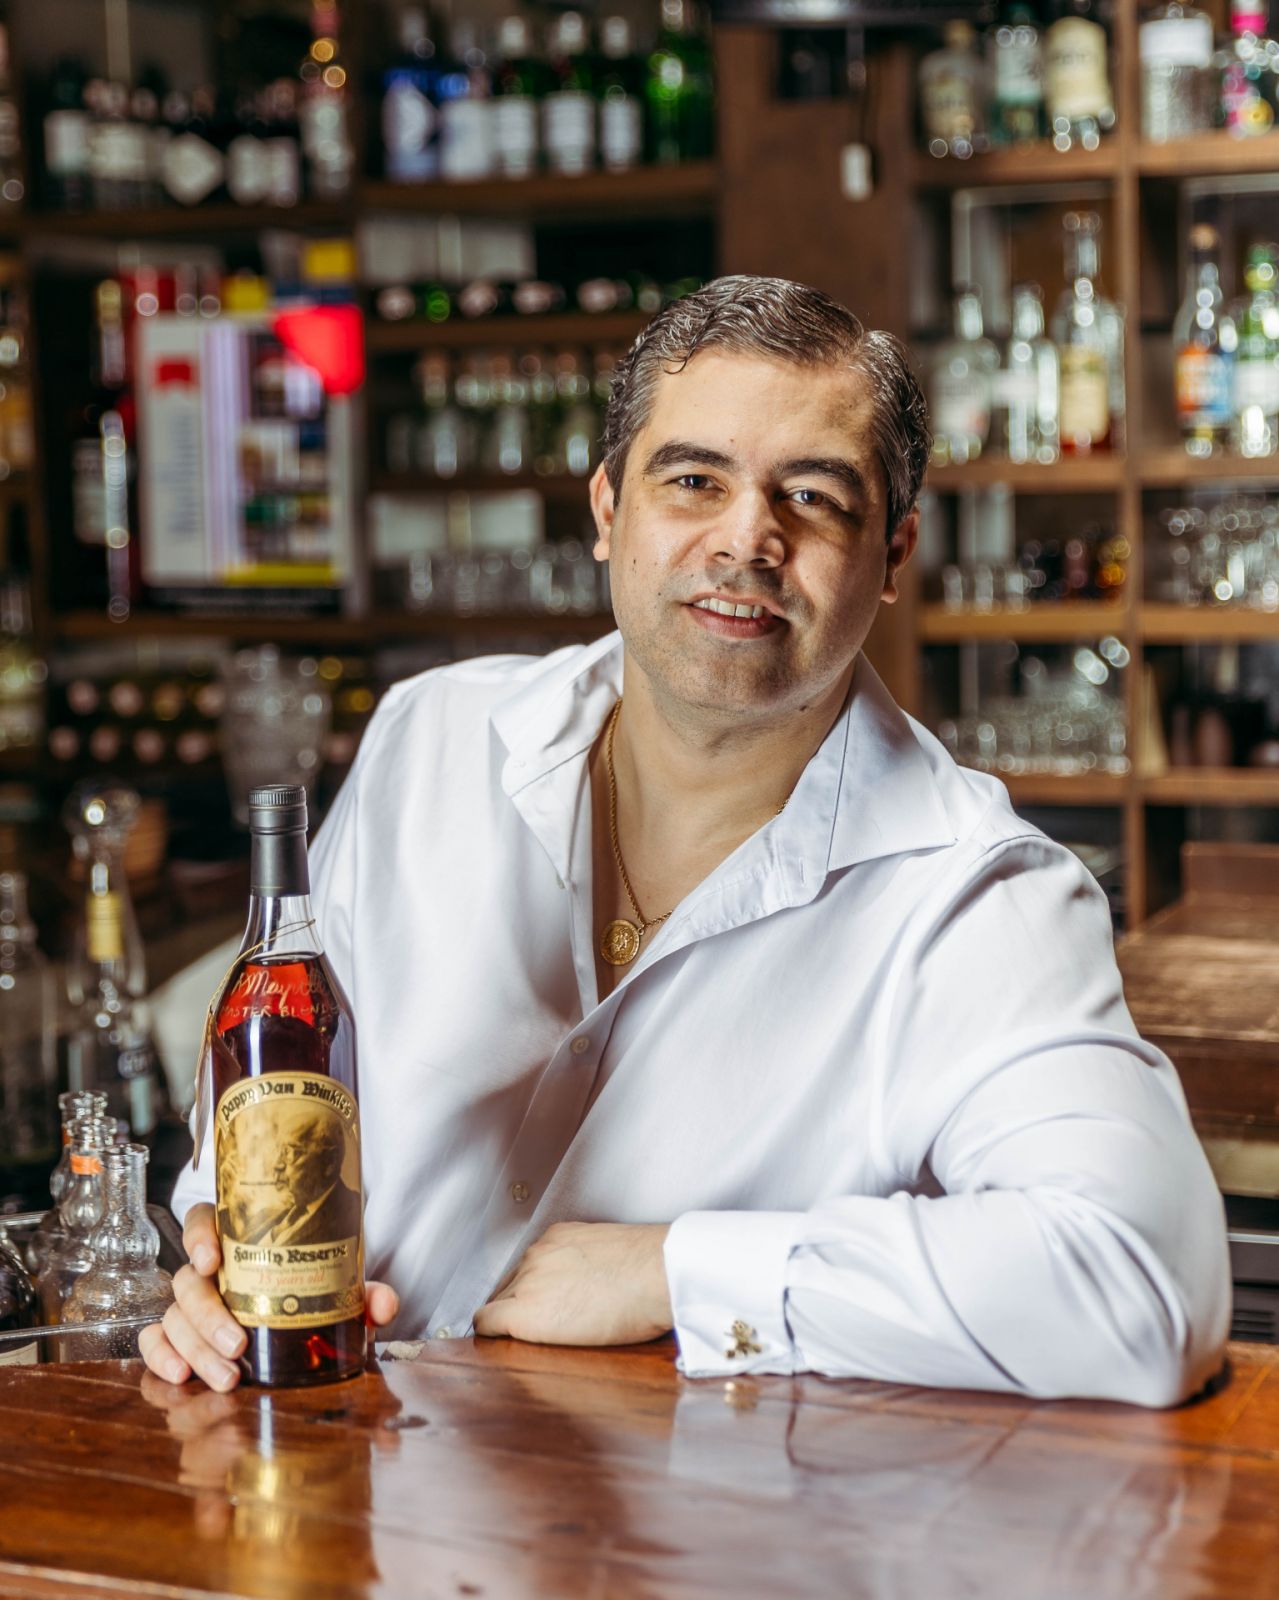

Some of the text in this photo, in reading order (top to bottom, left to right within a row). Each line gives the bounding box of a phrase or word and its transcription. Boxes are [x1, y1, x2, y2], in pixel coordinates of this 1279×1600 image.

[259, 1081, 294, 1096] Van
[234, 1245, 347, 1267] Family Reserve
